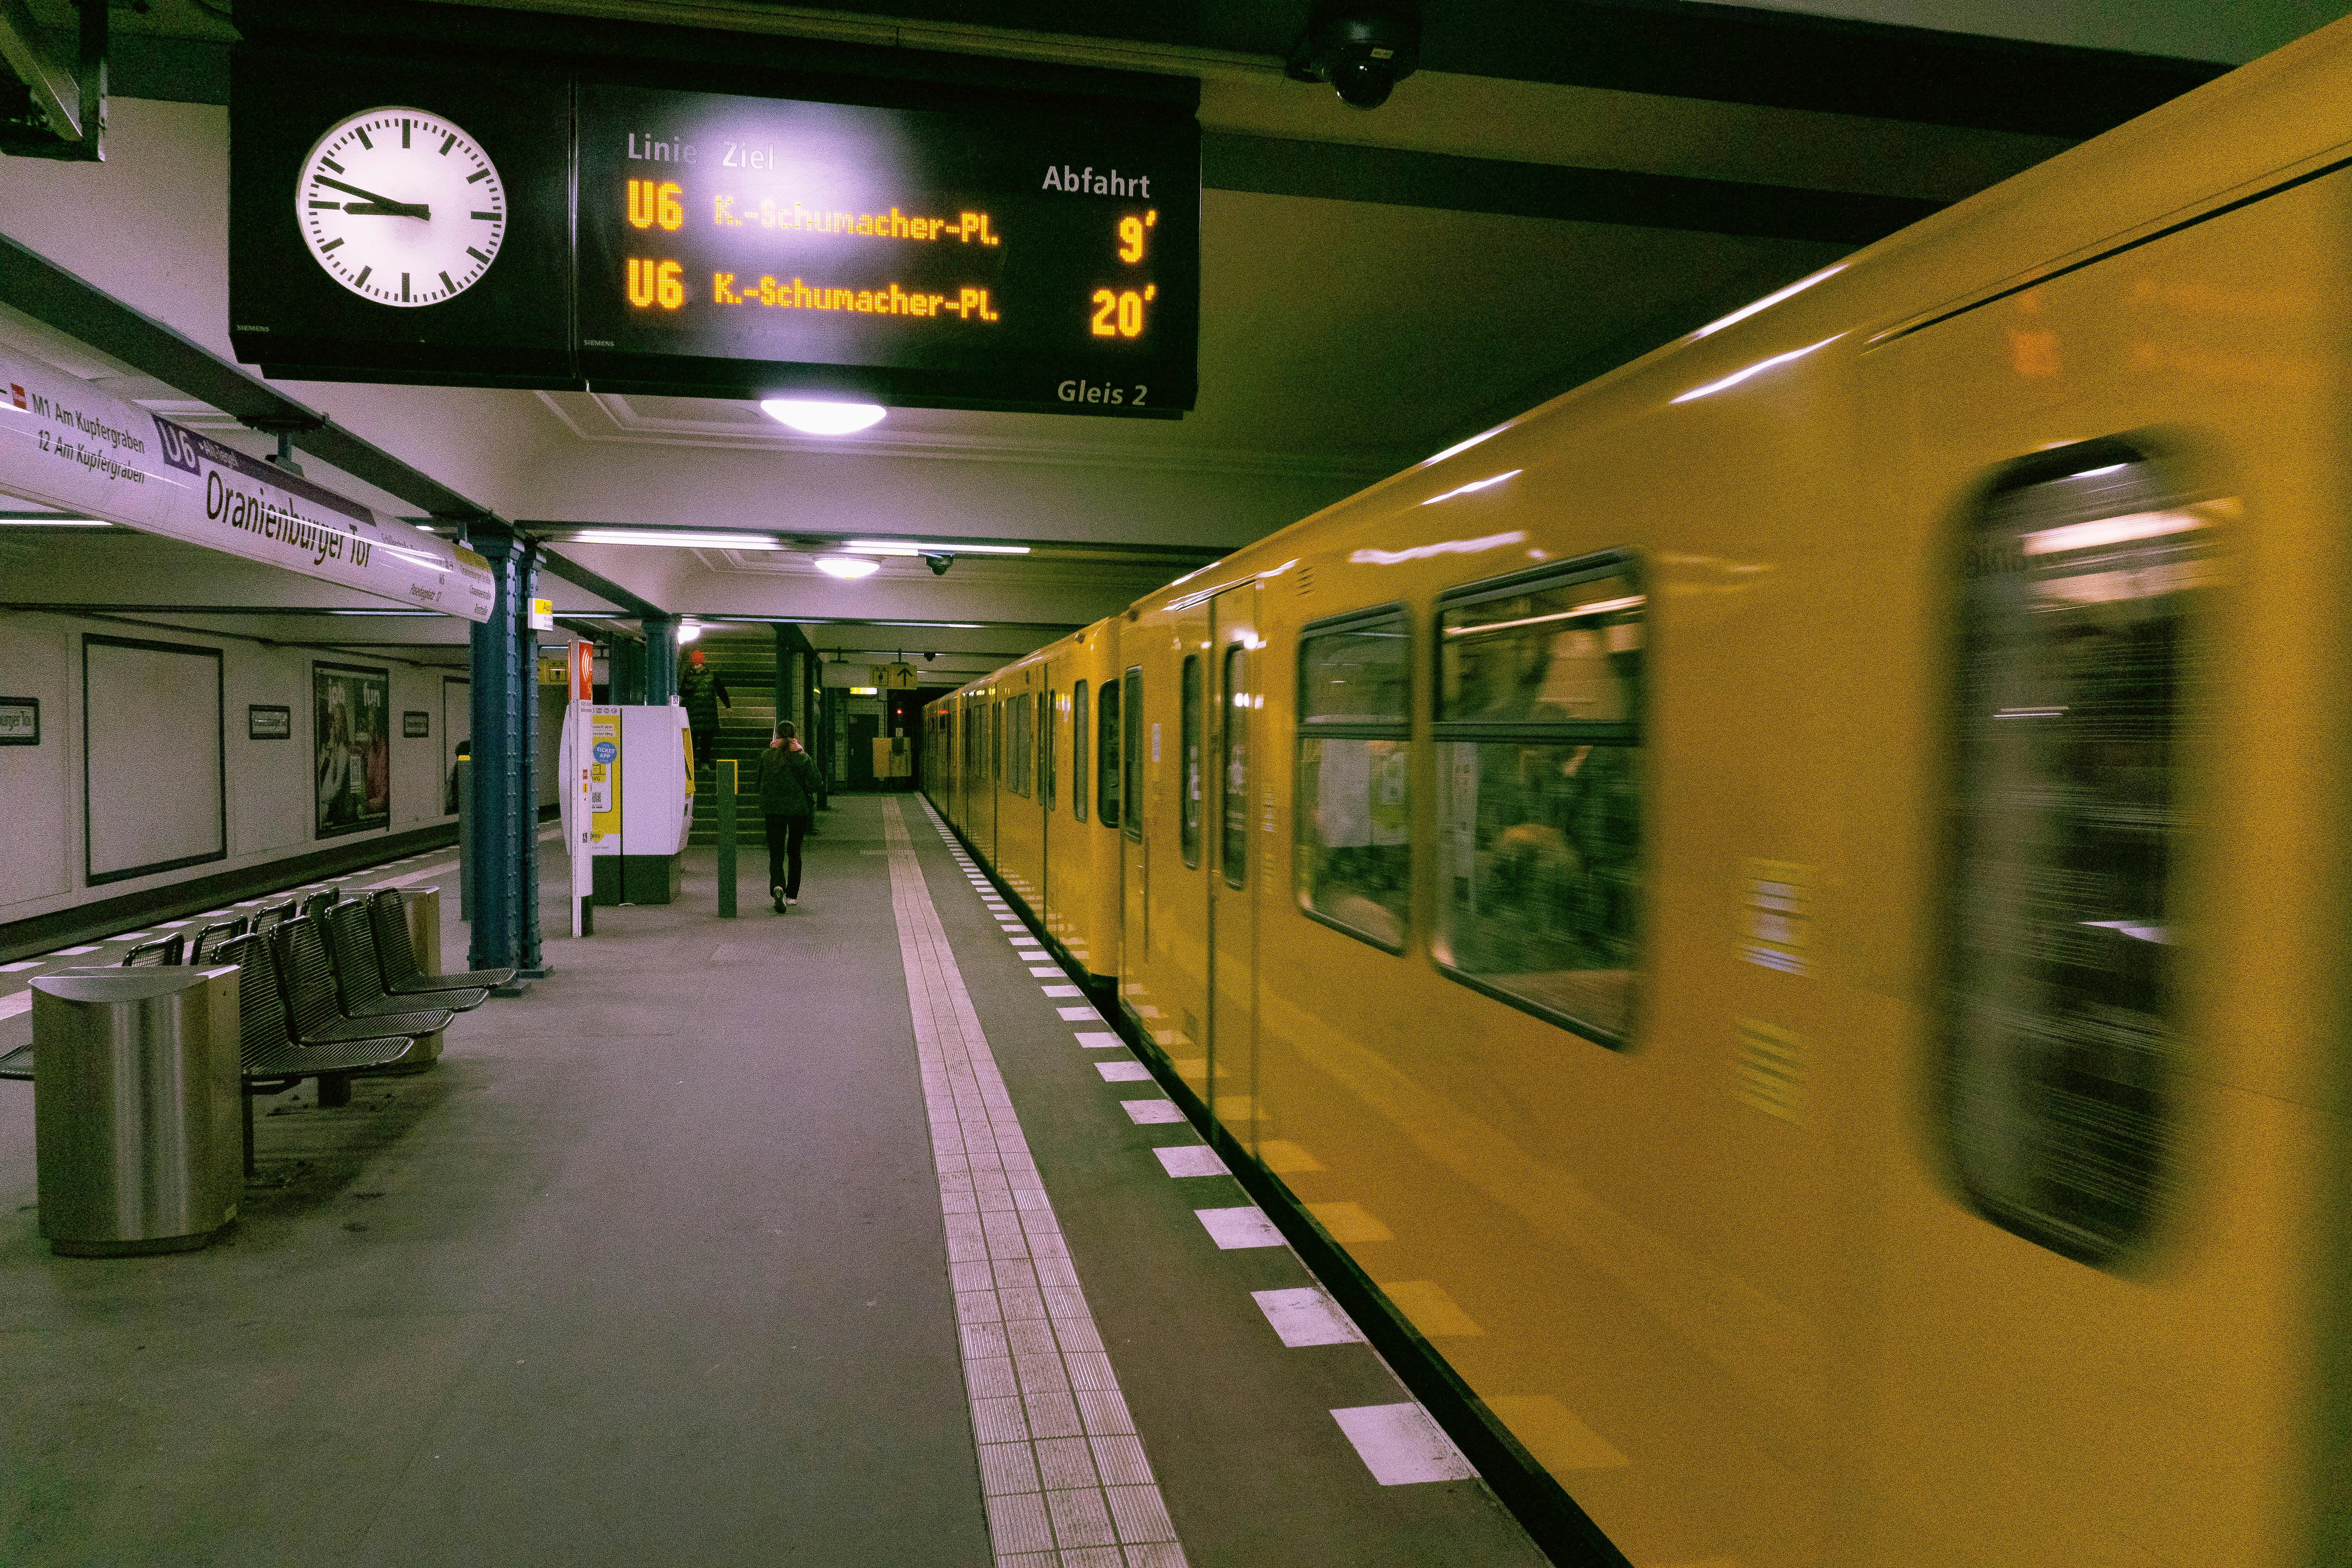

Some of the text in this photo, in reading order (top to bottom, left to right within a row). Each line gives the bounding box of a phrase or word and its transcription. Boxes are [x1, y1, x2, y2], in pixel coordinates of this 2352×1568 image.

[628, 133, 774, 170] Linie Ziel
[1042, 165, 1149, 198] Abfahrt
[629, 180, 683, 230] U6
[715, 195, 998, 245] K.-Schumacher-Pl.
[629, 259, 683, 309] U6
[715, 273, 998, 321] K.-Schumacher-Pl.
[1058, 380, 1147, 405] Gleis 2
[32, 393, 145, 454] M1 Am Kupfergraben
[159, 420, 196, 469] U6
[39, 430, 145, 484] 12 Am Kupfergraben
[207, 470, 372, 568] Oranienburger Tor
